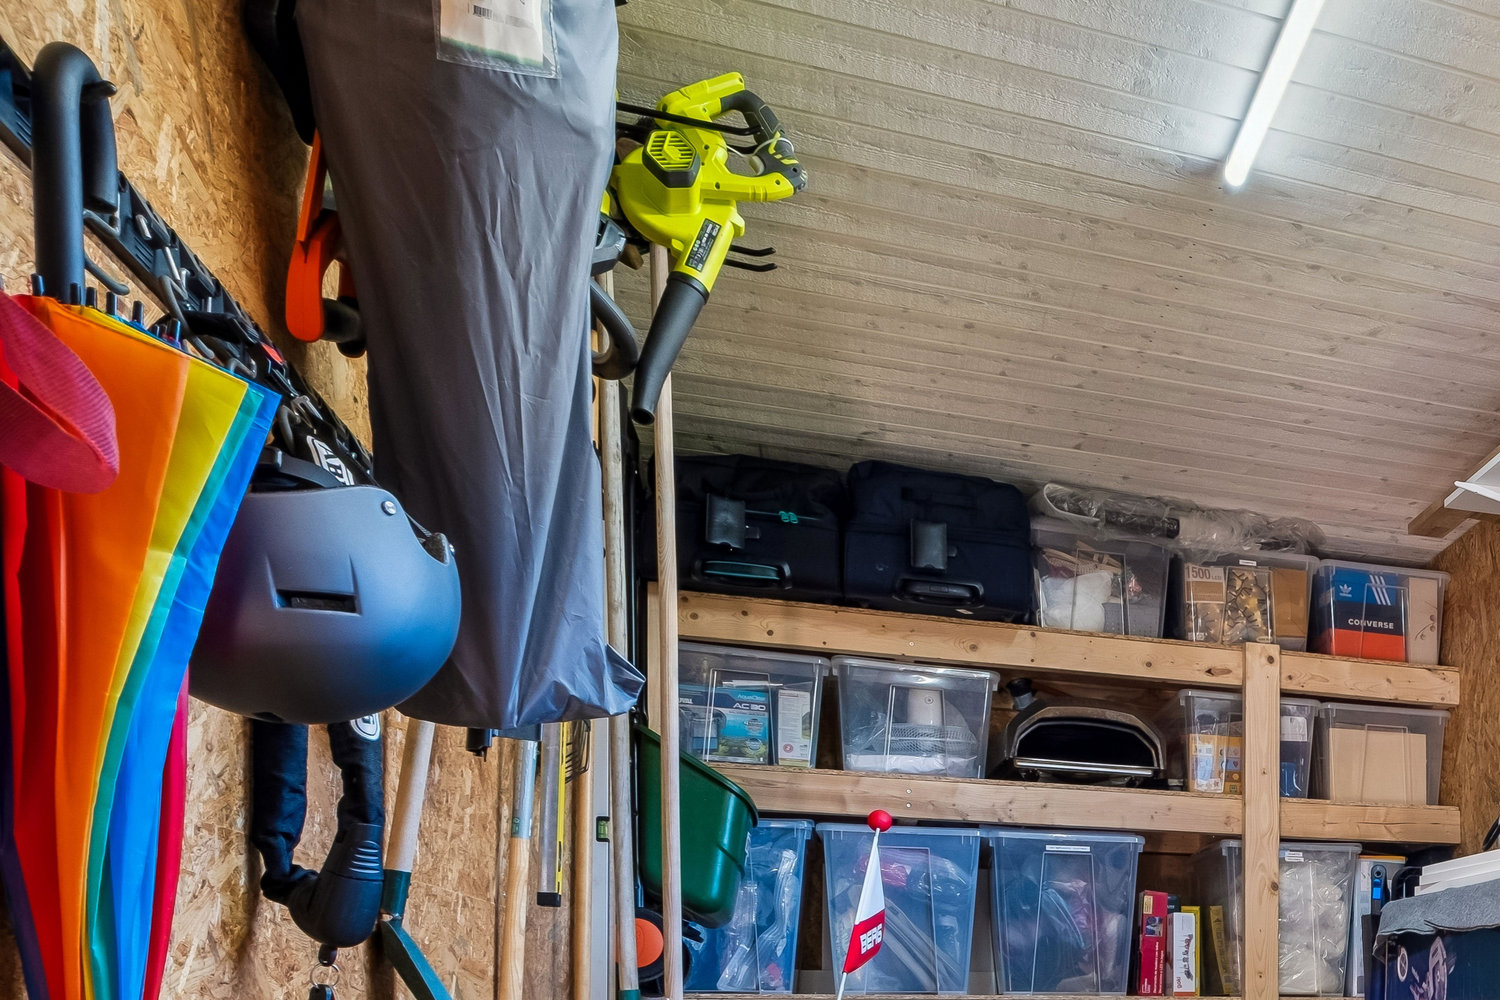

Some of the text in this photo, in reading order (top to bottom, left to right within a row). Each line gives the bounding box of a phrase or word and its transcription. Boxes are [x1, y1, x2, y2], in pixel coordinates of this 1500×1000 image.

[1187, 565, 1211, 581] 1500
[1348, 618, 1394, 629] CONVERSE
[733, 702, 750, 710] AC
[859, 923, 883, 954] BERG
